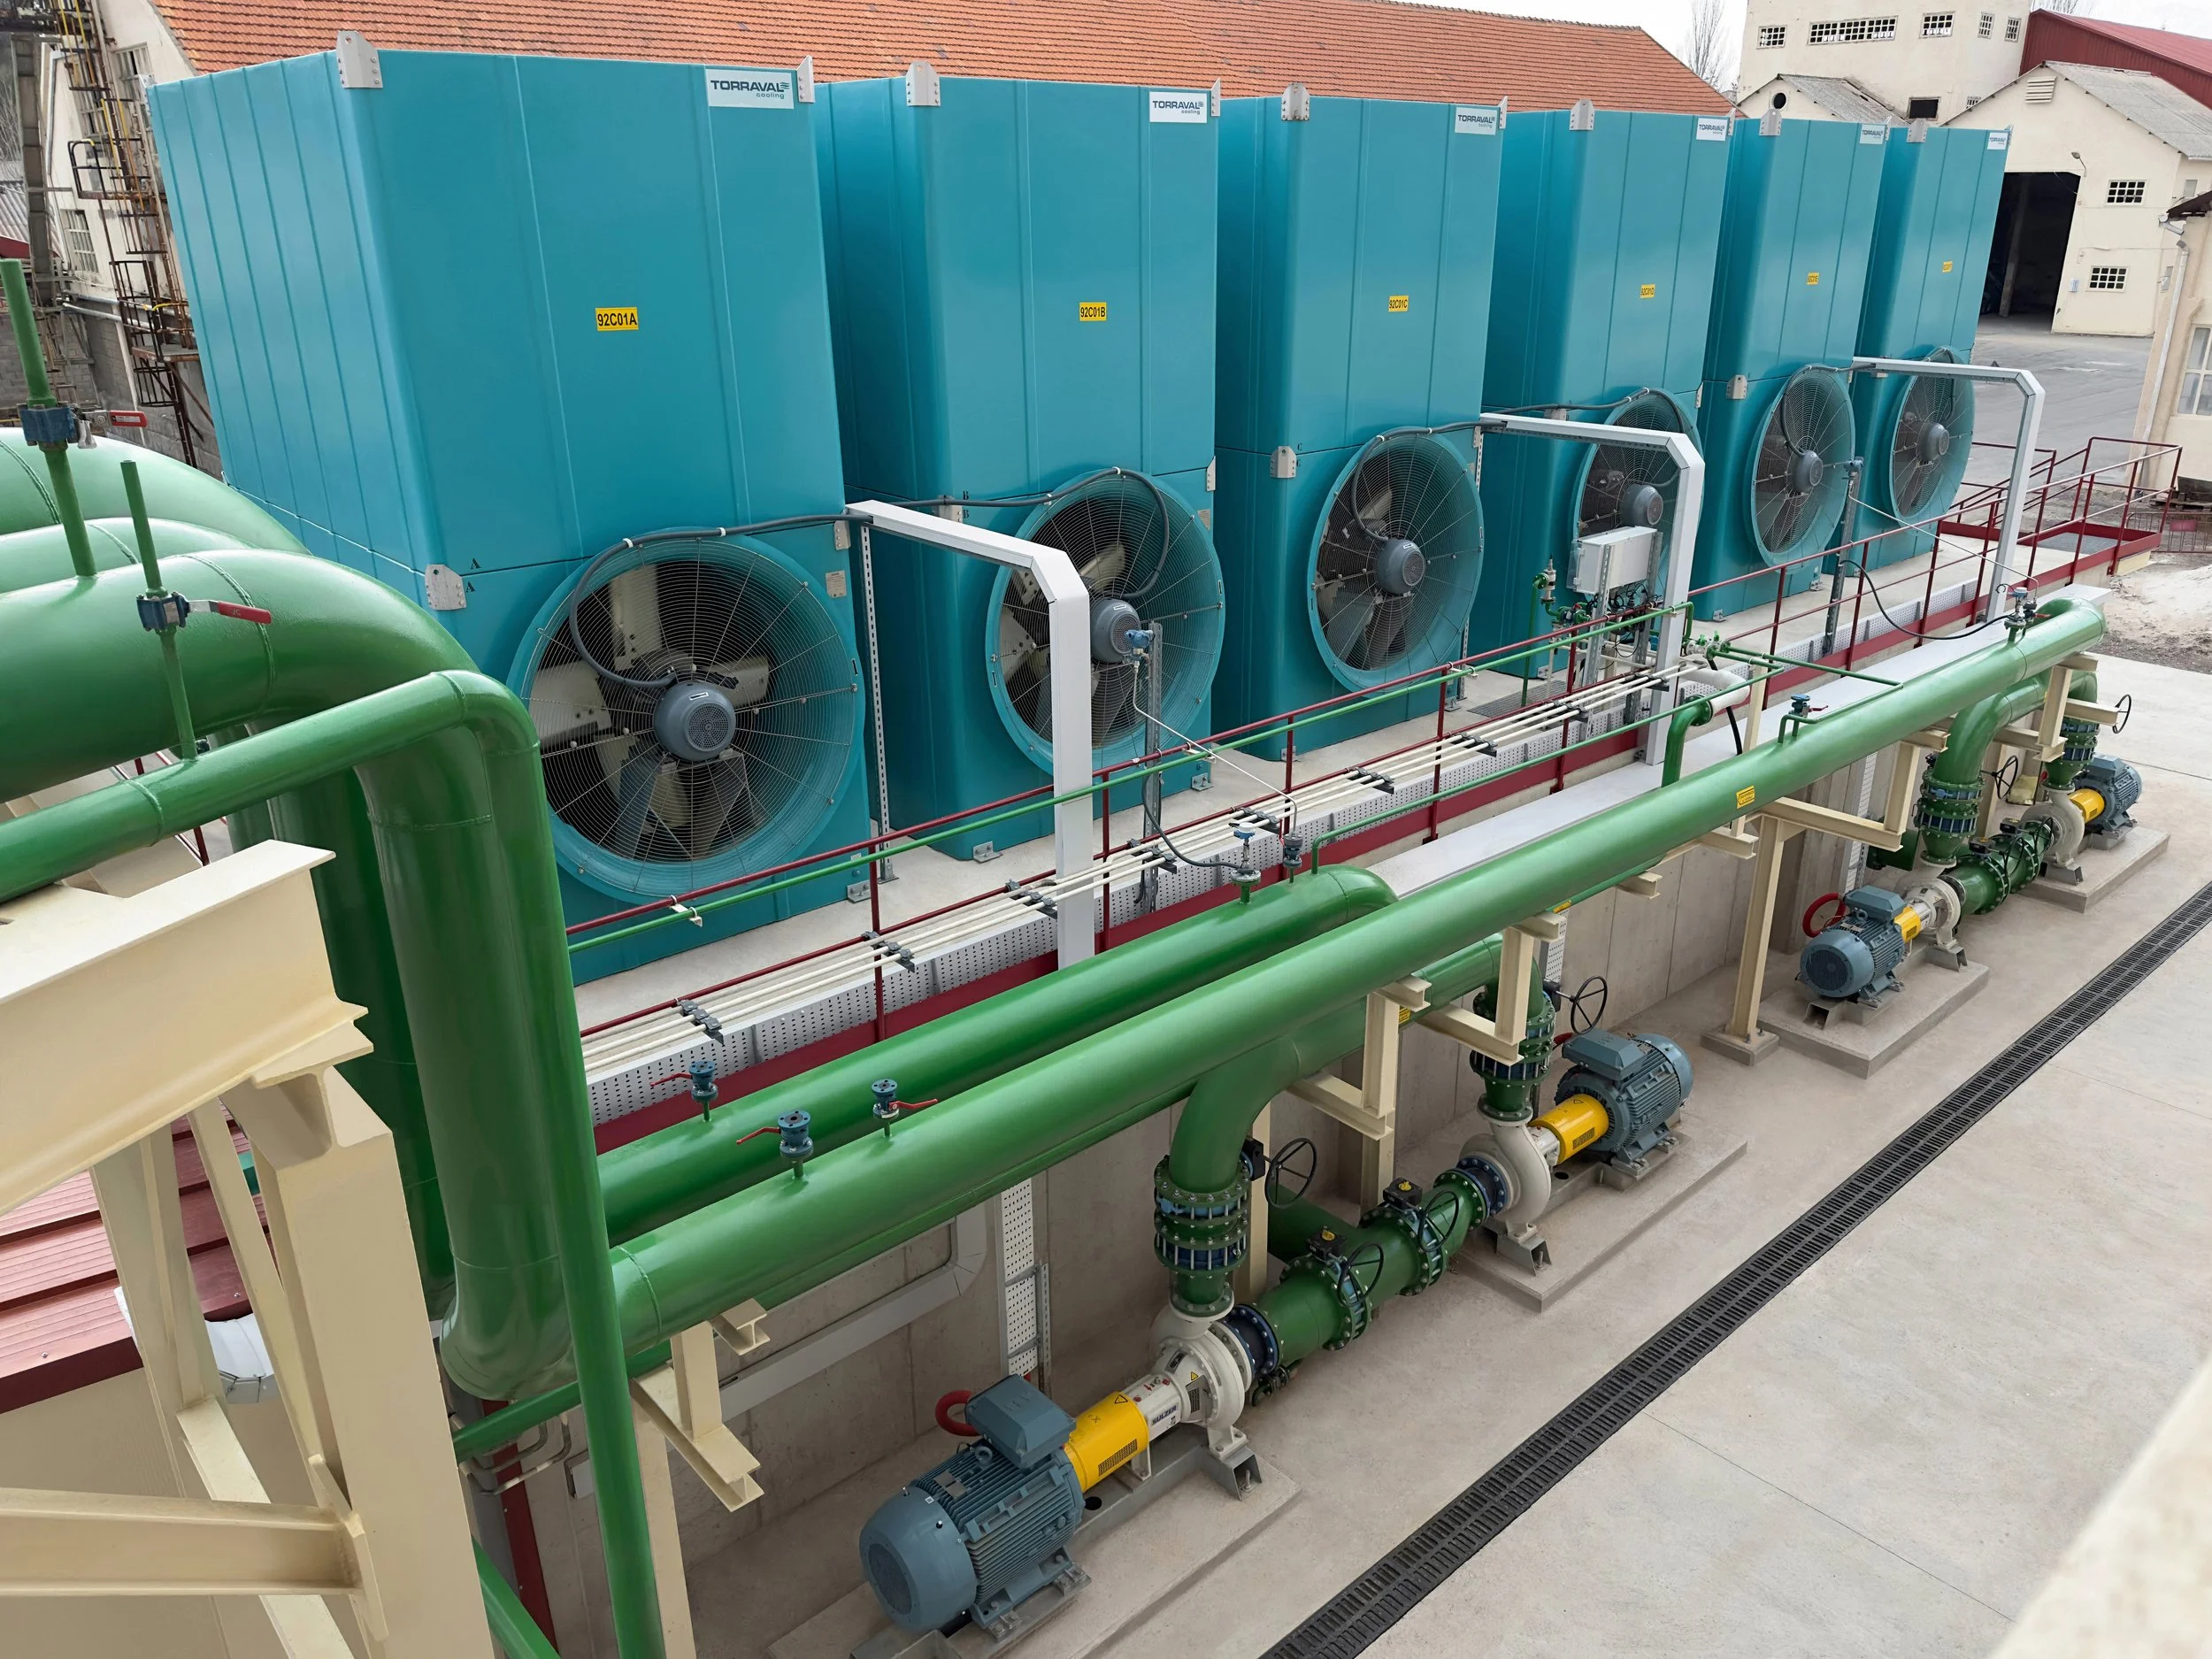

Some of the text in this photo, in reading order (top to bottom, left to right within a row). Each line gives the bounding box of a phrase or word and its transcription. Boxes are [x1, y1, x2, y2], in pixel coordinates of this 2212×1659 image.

[710, 81, 785, 92] TORRAVAL
[1152, 101, 1201, 110] TORRAVAL
[1389, 299, 1408, 309] 92C01C
[1080, 307, 1106, 318] 92C01B
[597, 312, 637, 326] 92C01A
[963, 490, 970, 500] B
[963, 510, 970, 518] B
[471, 557, 481, 569] A
[465, 581, 476, 592] A
[1152, 1405, 1177, 1425] SULZER
